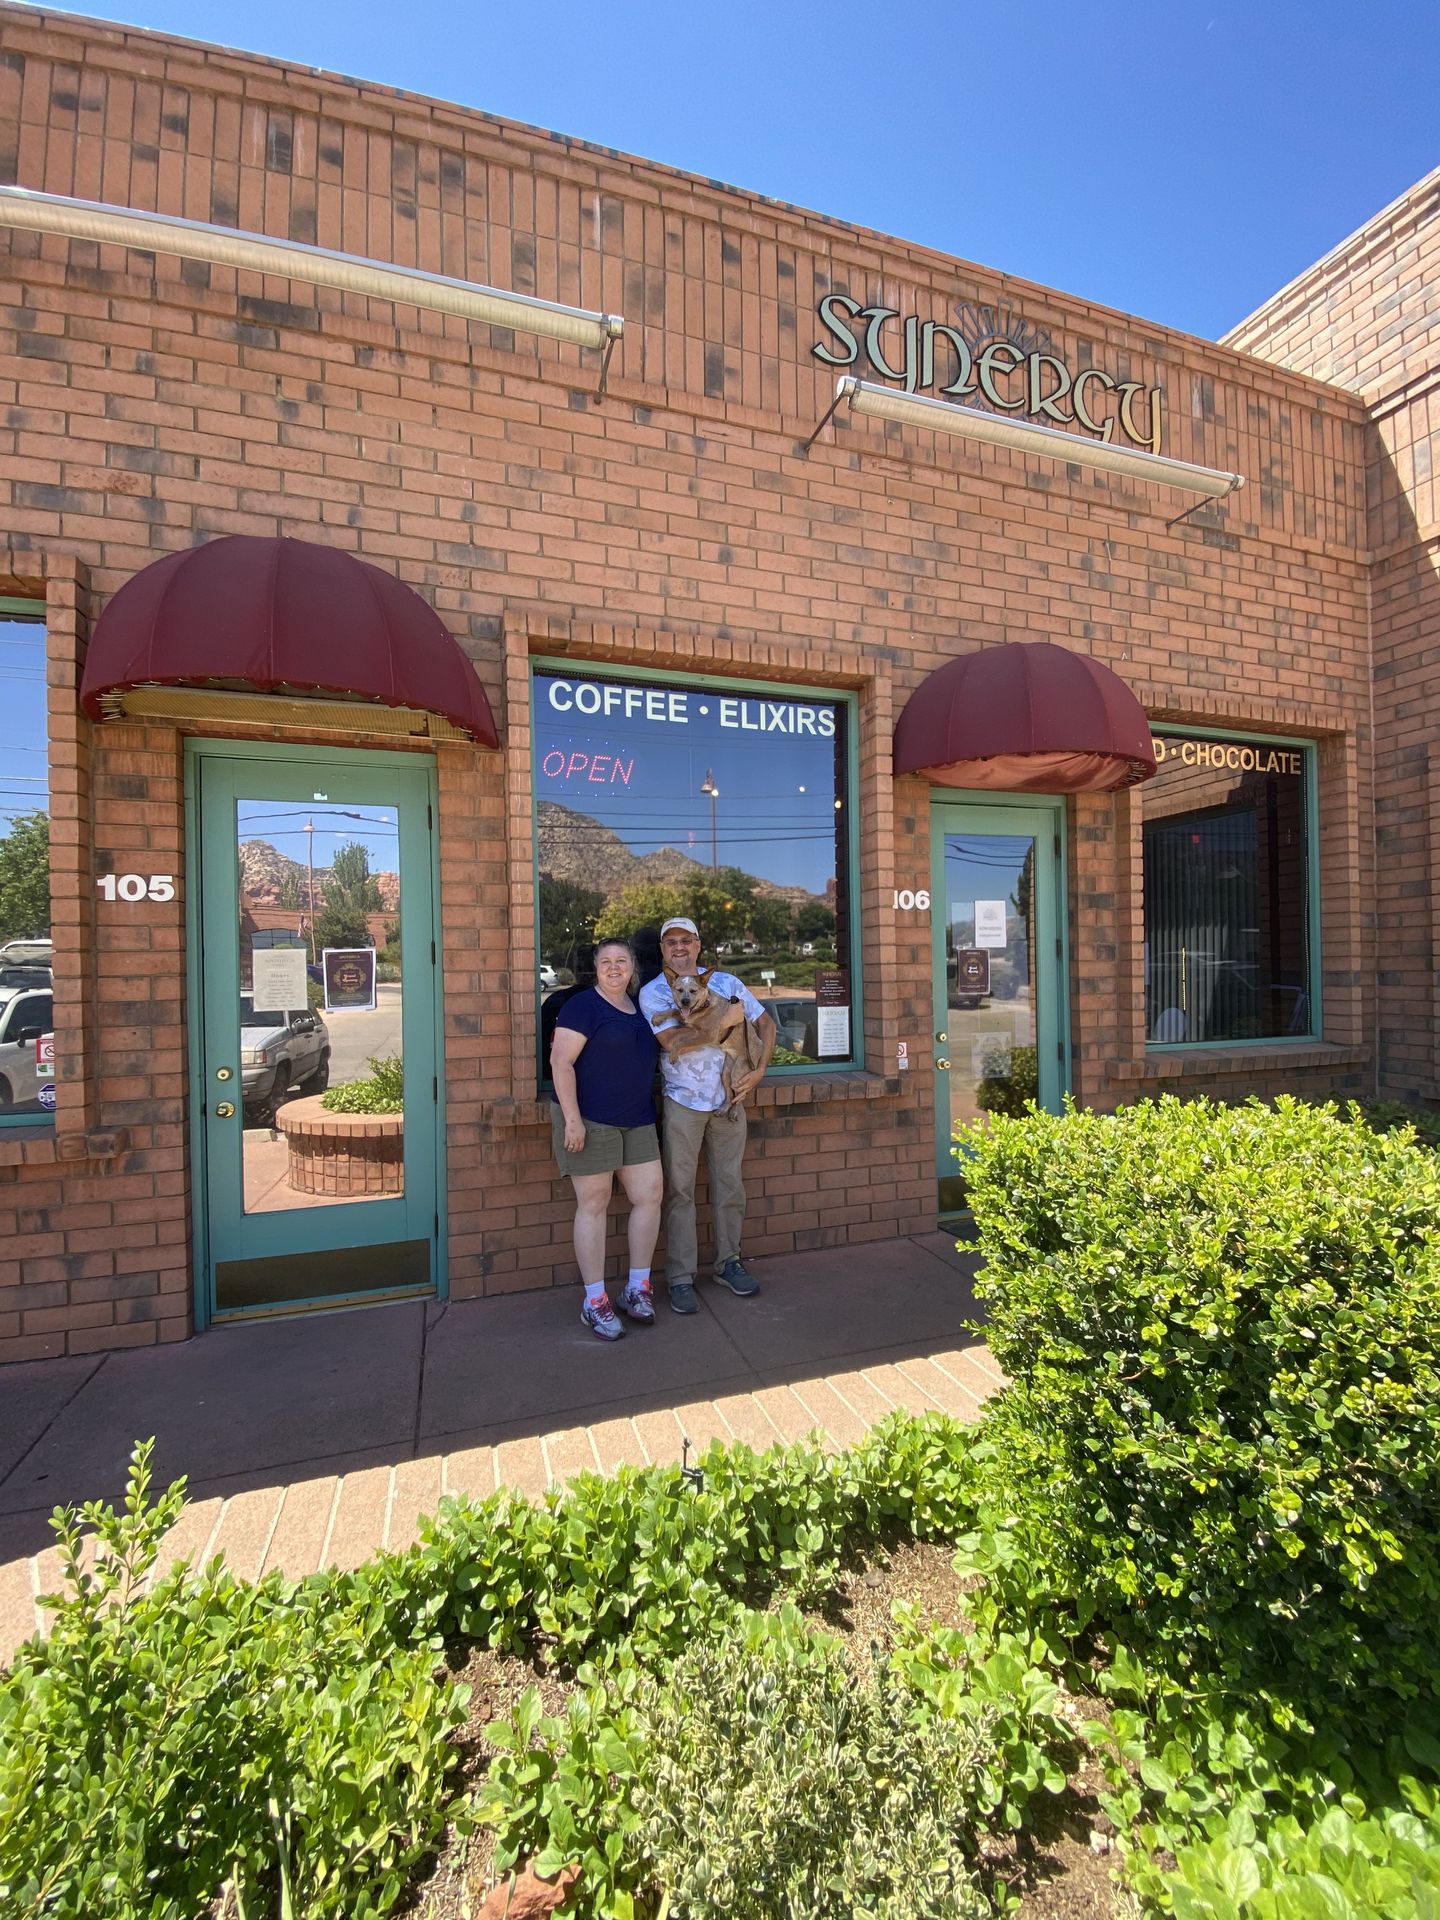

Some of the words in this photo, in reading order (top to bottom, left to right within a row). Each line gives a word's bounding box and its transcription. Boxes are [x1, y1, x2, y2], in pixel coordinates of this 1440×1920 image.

[811, 294, 1162, 456] SYNERGY
[549, 681, 689, 723] COFFEE
[720, 699, 836, 737] ELIXIRS
[543, 751, 634, 785] OPEN
[1182, 742, 1301, 775] CHOCOLATE
[97, 874, 175, 902] 105
[892, 889, 930, 910] 106
